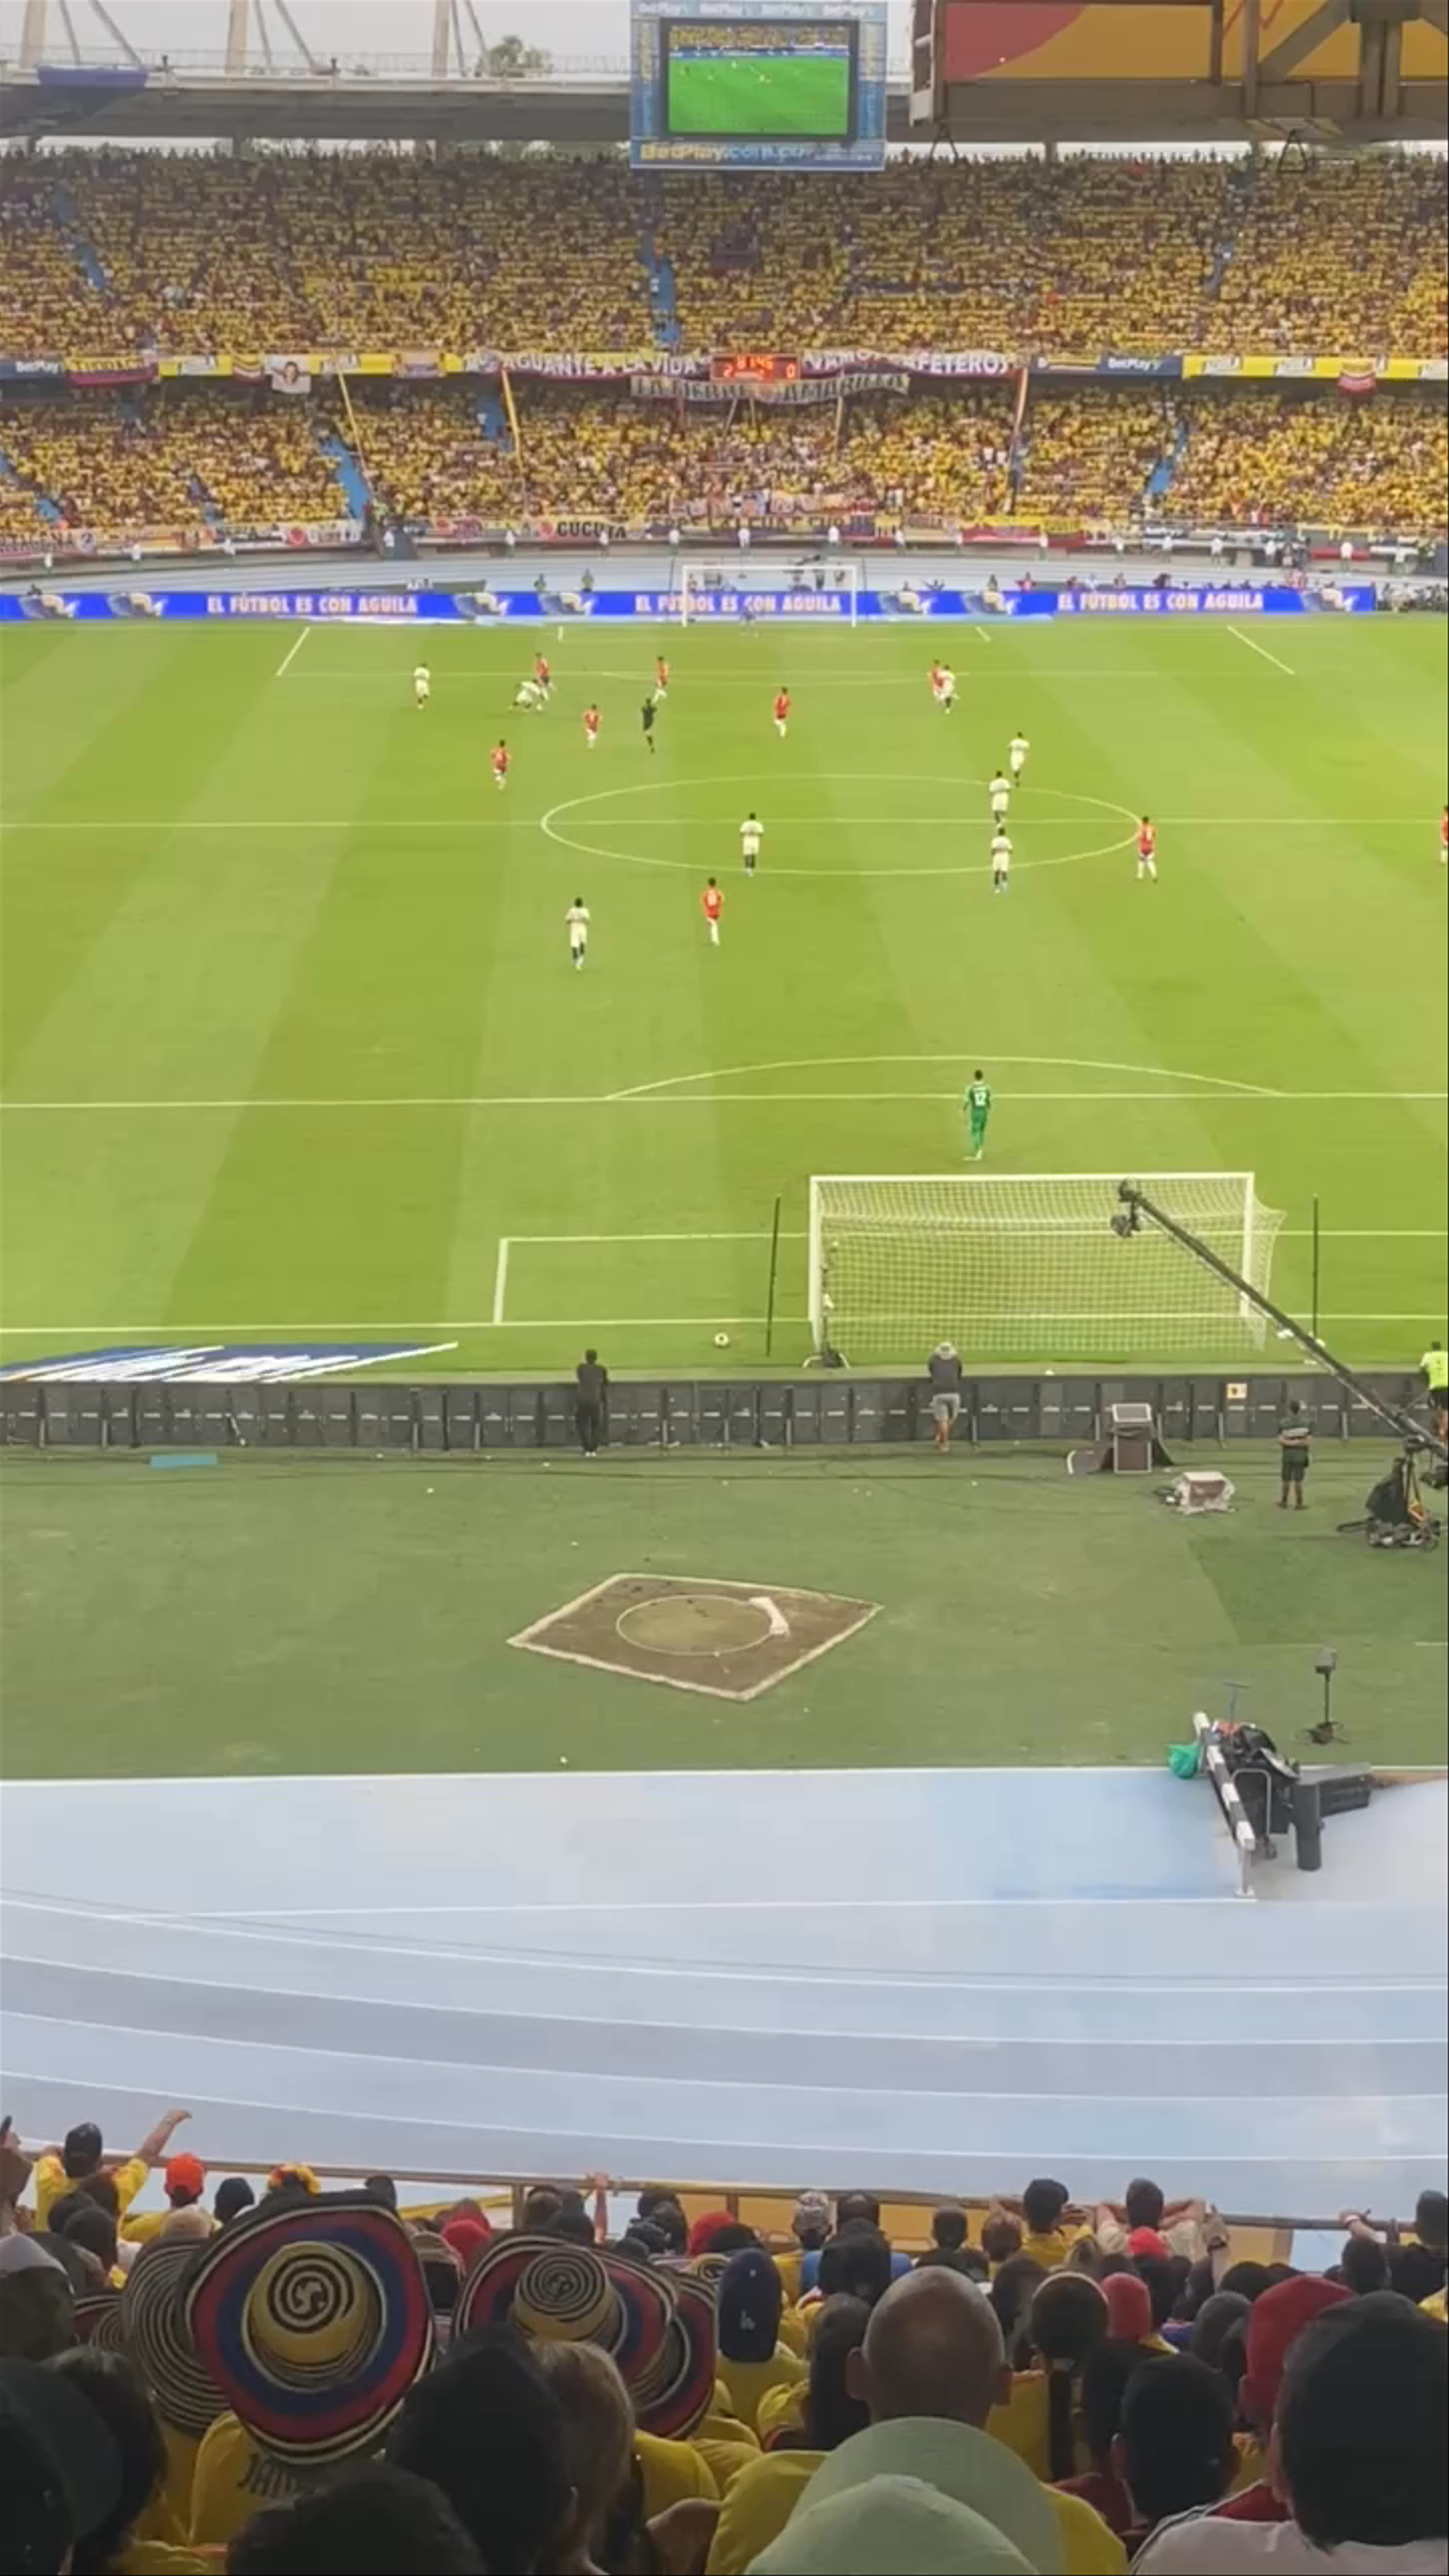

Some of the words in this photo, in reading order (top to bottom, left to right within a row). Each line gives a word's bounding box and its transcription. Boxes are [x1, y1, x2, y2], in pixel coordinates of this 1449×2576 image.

[651, 355, 697, 375] VIDA
[811, 350, 881, 371] VAMO
[893, 352, 1009, 374] AFETEROS
[1108, 357, 1151, 371] BetPlay
[208, 595, 224, 612] EL
[296, 595, 311, 612] ES
[319, 595, 352, 612] CON
[635, 595, 651, 612] EL
[721, 595, 737, 612] ES
[744, 595, 776, 611] CON
[1058, 594, 1074, 610] EL
[1144, 594, 1159, 610] ES
[1167, 593, 1198, 610] CON
